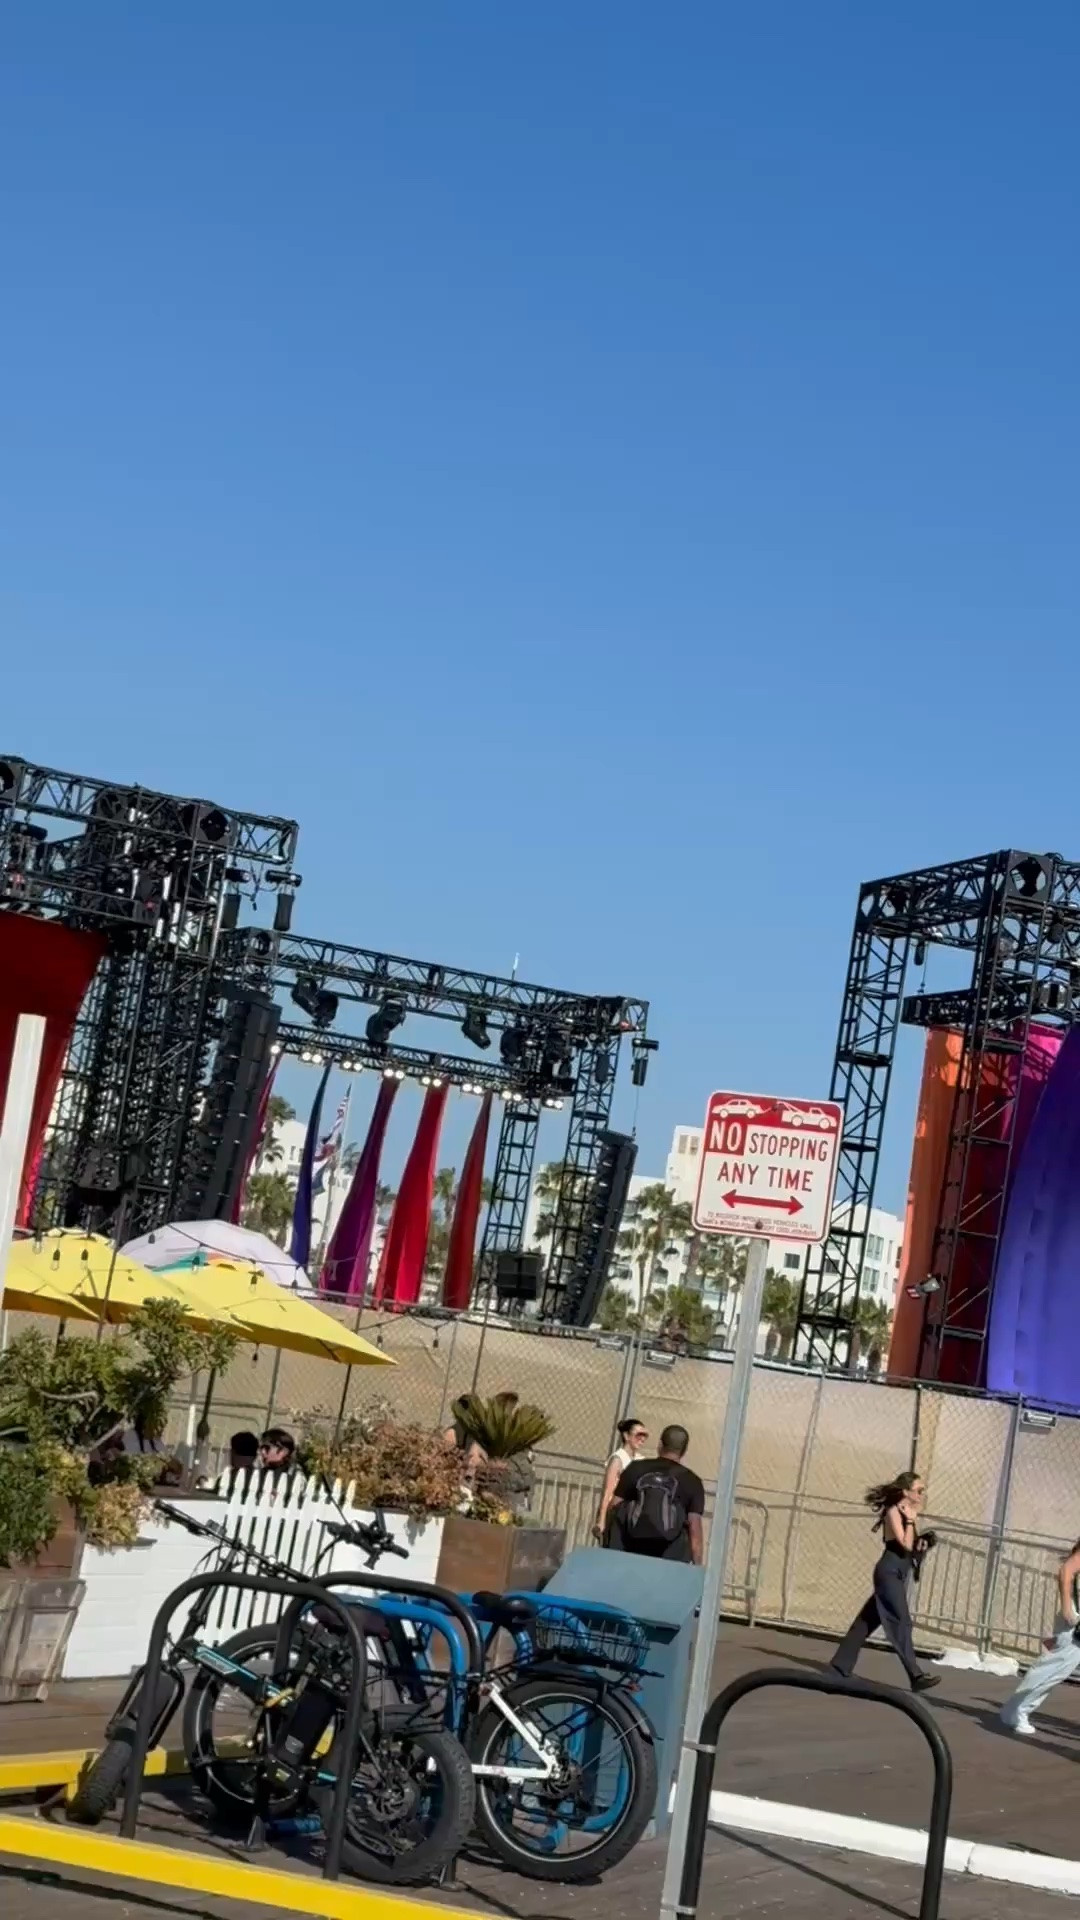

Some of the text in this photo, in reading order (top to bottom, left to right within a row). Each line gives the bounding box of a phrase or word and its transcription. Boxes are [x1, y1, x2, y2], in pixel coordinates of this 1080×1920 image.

[709, 1120, 829, 1162] NO STOPPING
[717, 1161, 814, 1192] ANY TIME
